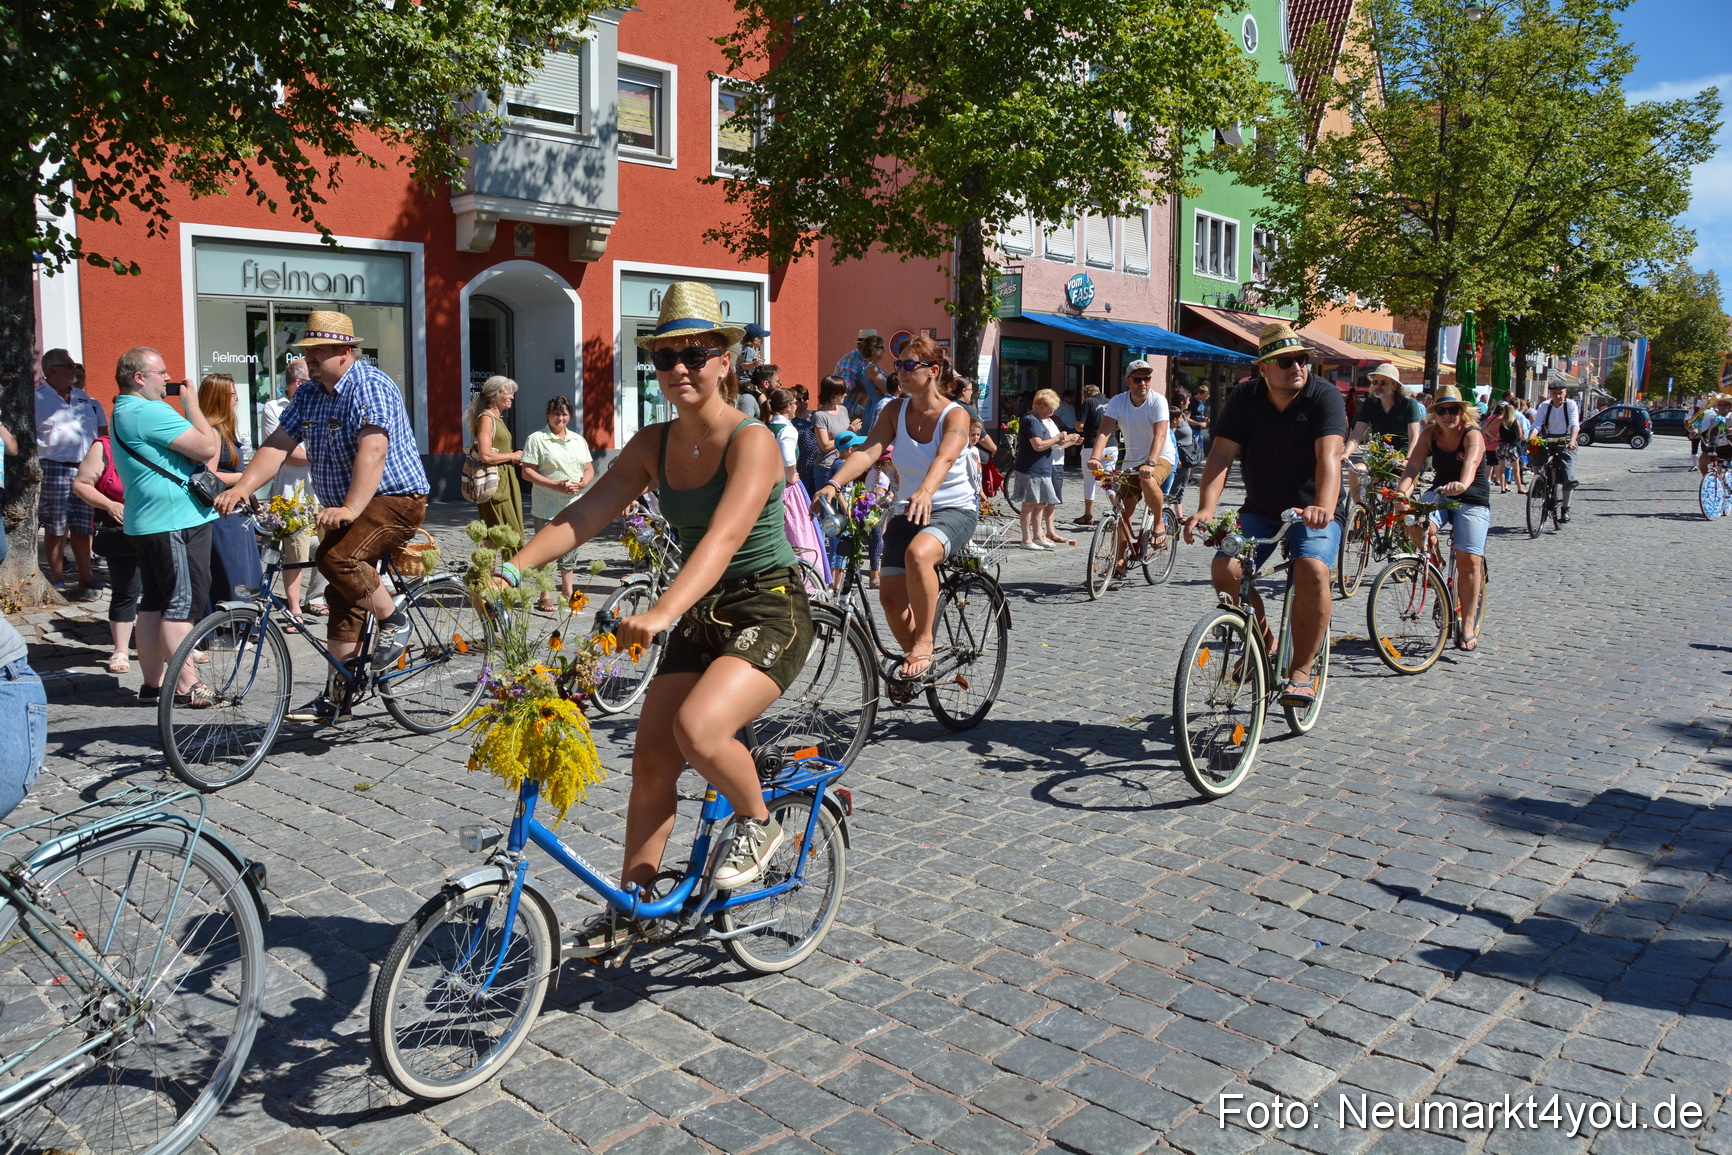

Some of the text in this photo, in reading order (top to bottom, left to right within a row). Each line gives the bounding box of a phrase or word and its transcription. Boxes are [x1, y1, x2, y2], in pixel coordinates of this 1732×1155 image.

[243, 259, 366, 294] fielmann
[1000, 284, 1017, 296] FASS
[1067, 277, 1083, 290] vom
[1071, 285, 1094, 304] FASS
[212, 351, 259, 364] fielmann
